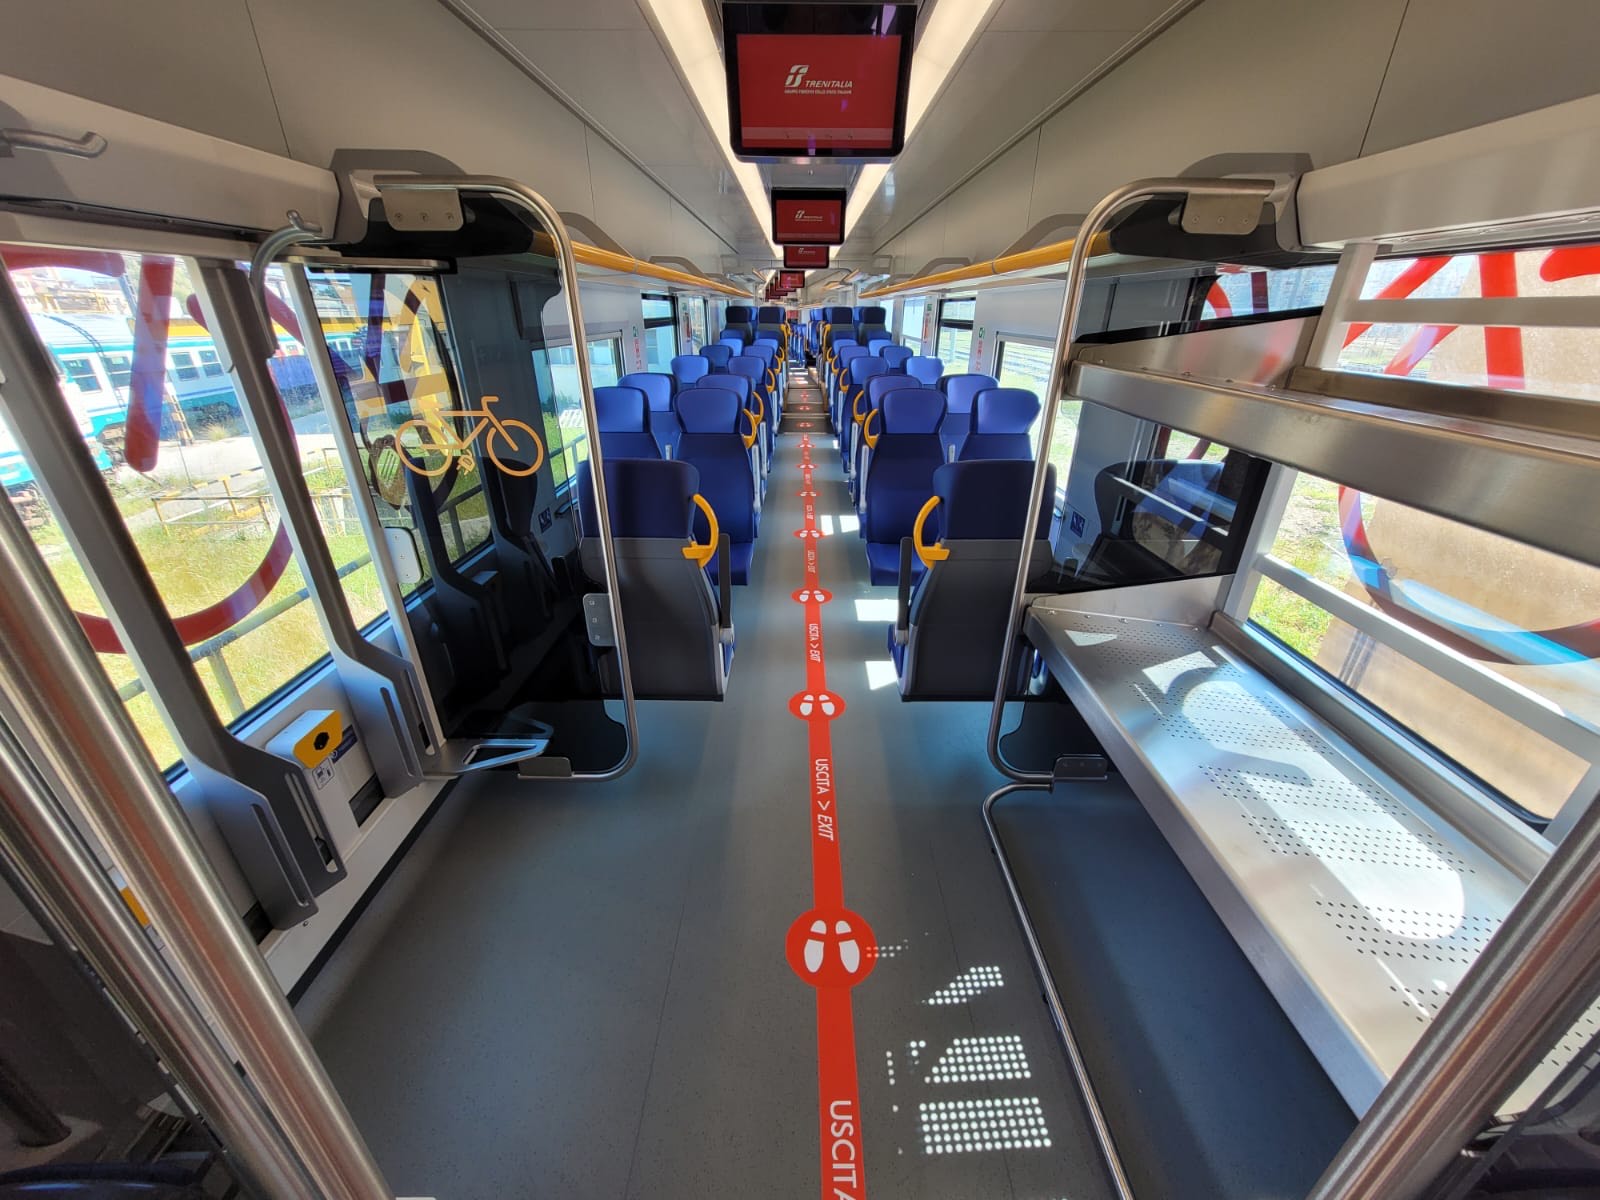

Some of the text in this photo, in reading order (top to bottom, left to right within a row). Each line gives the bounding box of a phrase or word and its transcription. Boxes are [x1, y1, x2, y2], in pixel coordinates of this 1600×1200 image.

[805, 80, 853, 88] TRENITALIA
[815, 758, 834, 841] USCITA EXIT
